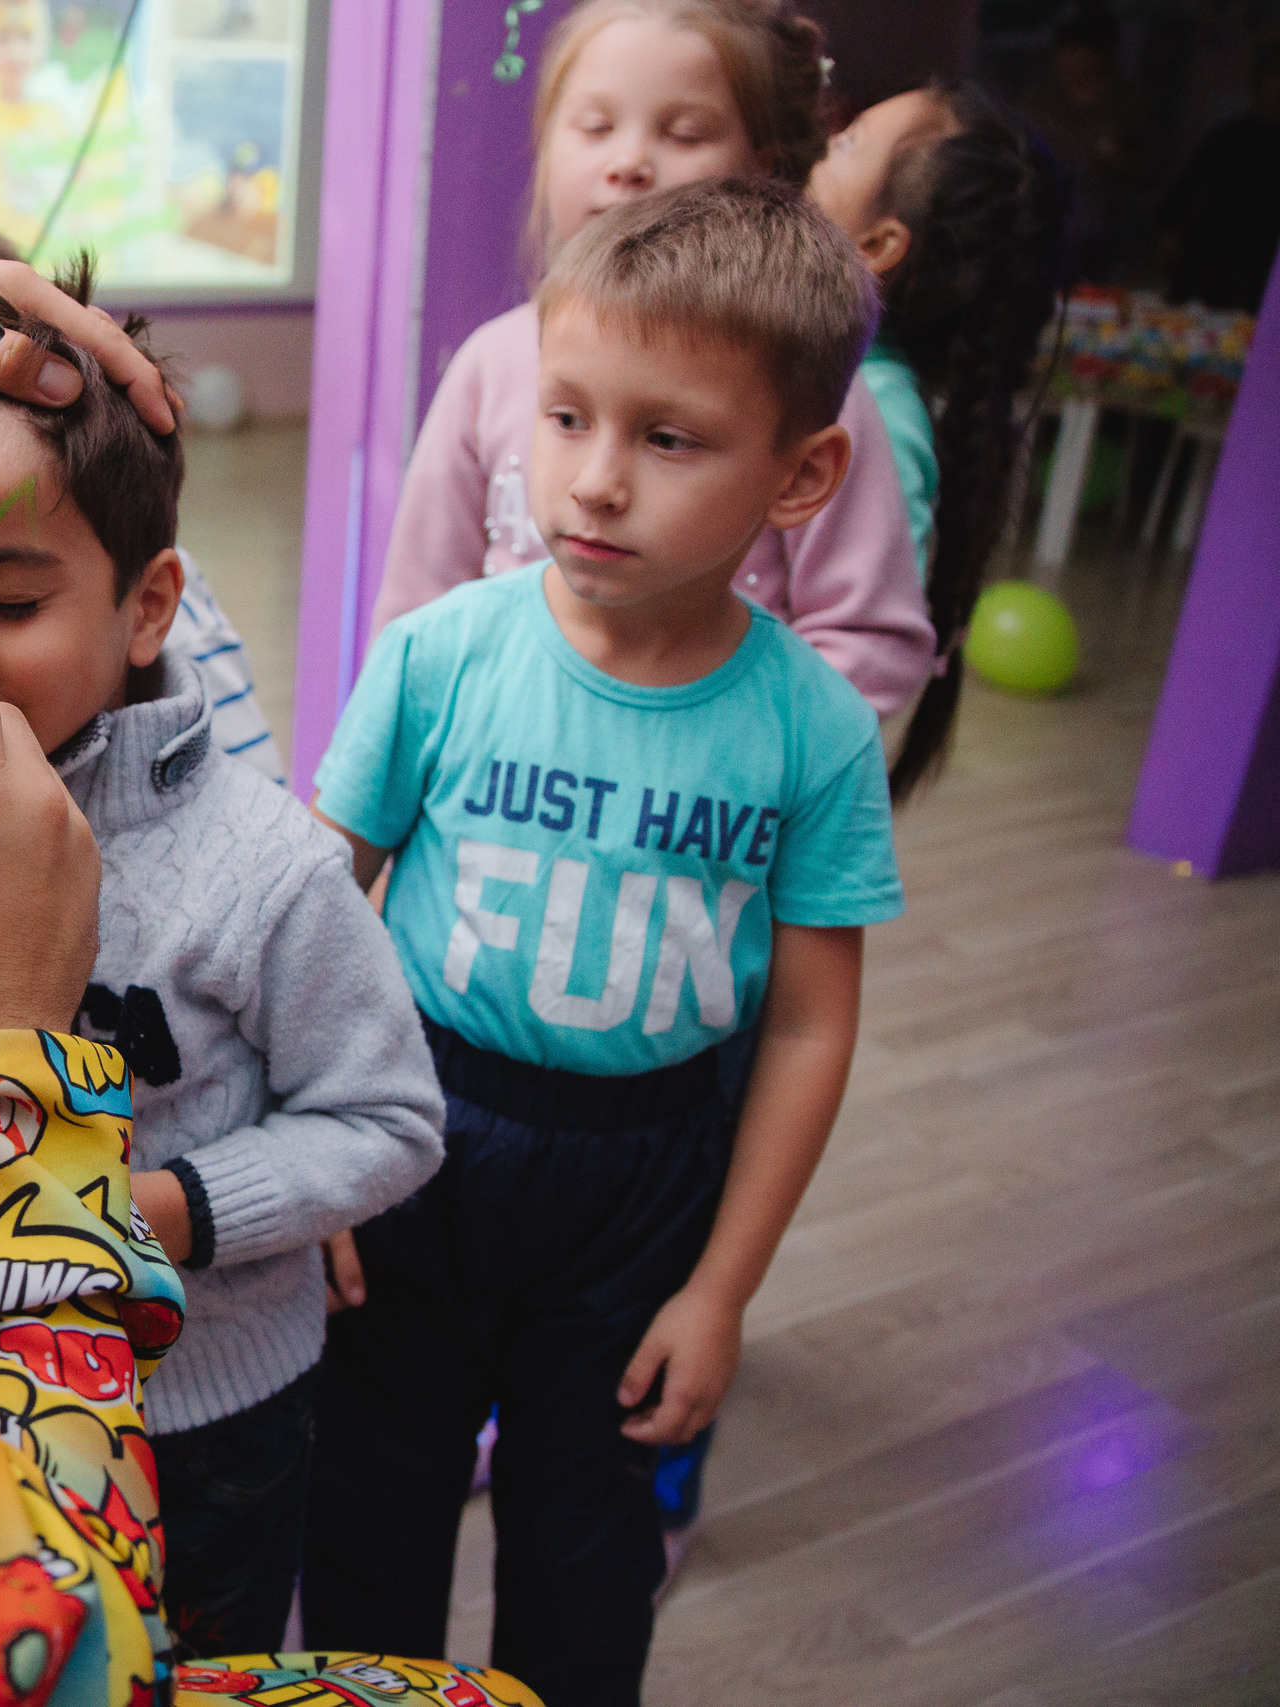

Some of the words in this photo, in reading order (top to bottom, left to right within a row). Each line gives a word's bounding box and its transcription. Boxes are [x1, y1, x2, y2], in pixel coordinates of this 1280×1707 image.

[464, 760, 618, 840] JUST
[633, 787, 780, 866] HAVE
[442, 838, 760, 1037] FUN
